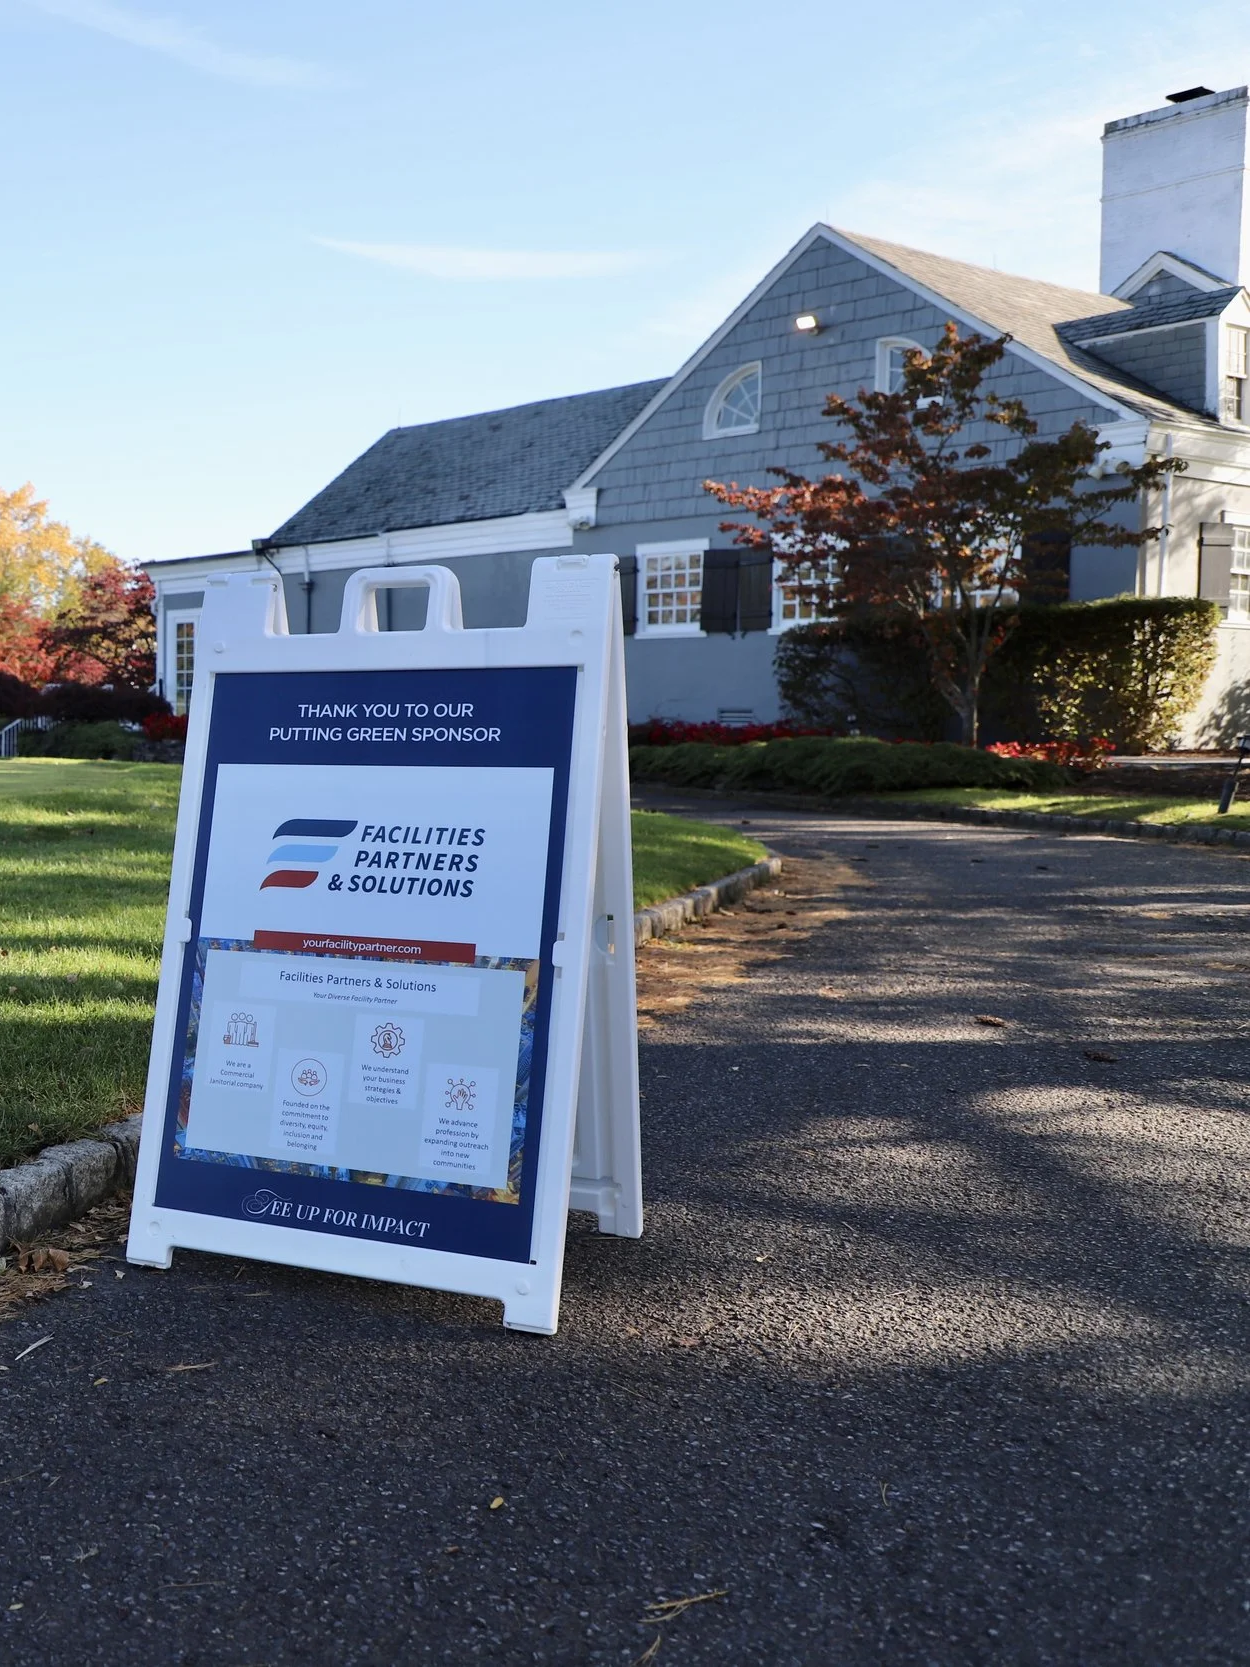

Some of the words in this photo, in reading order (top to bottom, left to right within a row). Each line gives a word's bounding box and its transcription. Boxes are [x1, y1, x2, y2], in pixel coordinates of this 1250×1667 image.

[298, 704, 358, 718] THANK
[362, 704, 400, 718] YOU
[404, 704, 429, 718] TO
[433, 703, 474, 718] OUR
[269, 727, 342, 741] PUTTING
[346, 727, 407, 741] GREEN
[411, 727, 501, 742] SPONSOR
[360, 825, 486, 846] FACILITIES
[354, 850, 479, 872] PARTNERS
[327, 873, 343, 891] &
[347, 874, 474, 898] SOLUTIONS
[302, 938, 422, 954] yourfacilitypartner.com
[279, 970, 324, 983] Facilities
[326, 974, 371, 987] Partners
[374, 978, 383, 988] &
[386, 978, 437, 992] Solutions
[327, 993, 350, 1001] Diverse
[350, 994, 373, 1003] Facility
[373, 996, 398, 1005] Partner
[220, 1069, 255, 1079] Commercial
[372, 1066, 409, 1075] understand
[209, 1078, 236, 1087] Janitorial
[236, 1081, 264, 1090] company
[378, 1075, 406, 1085] business
[364, 1085, 395, 1094] strategies
[282, 1100, 309, 1109] Founded
[366, 1096, 398, 1105] objectives
[281, 1110, 321, 1120] commitment
[450, 1120, 478, 1129] advance
[283, 1130, 311, 1139] inclusion
[311, 1133, 323, 1141] and
[435, 1128, 470, 1138] profession
[470, 1132, 479, 1140] by
[287, 1140, 317, 1151] belonging
[424, 1138, 458, 1148] expanding
[458, 1142, 489, 1151] outreach
[432, 1160, 476, 1170] communities
[242, 1188, 293, 1219] TEE
[296, 1204, 321, 1221] UP
[322, 1208, 357, 1228] FOR
[360, 1213, 430, 1238] IMPACT
